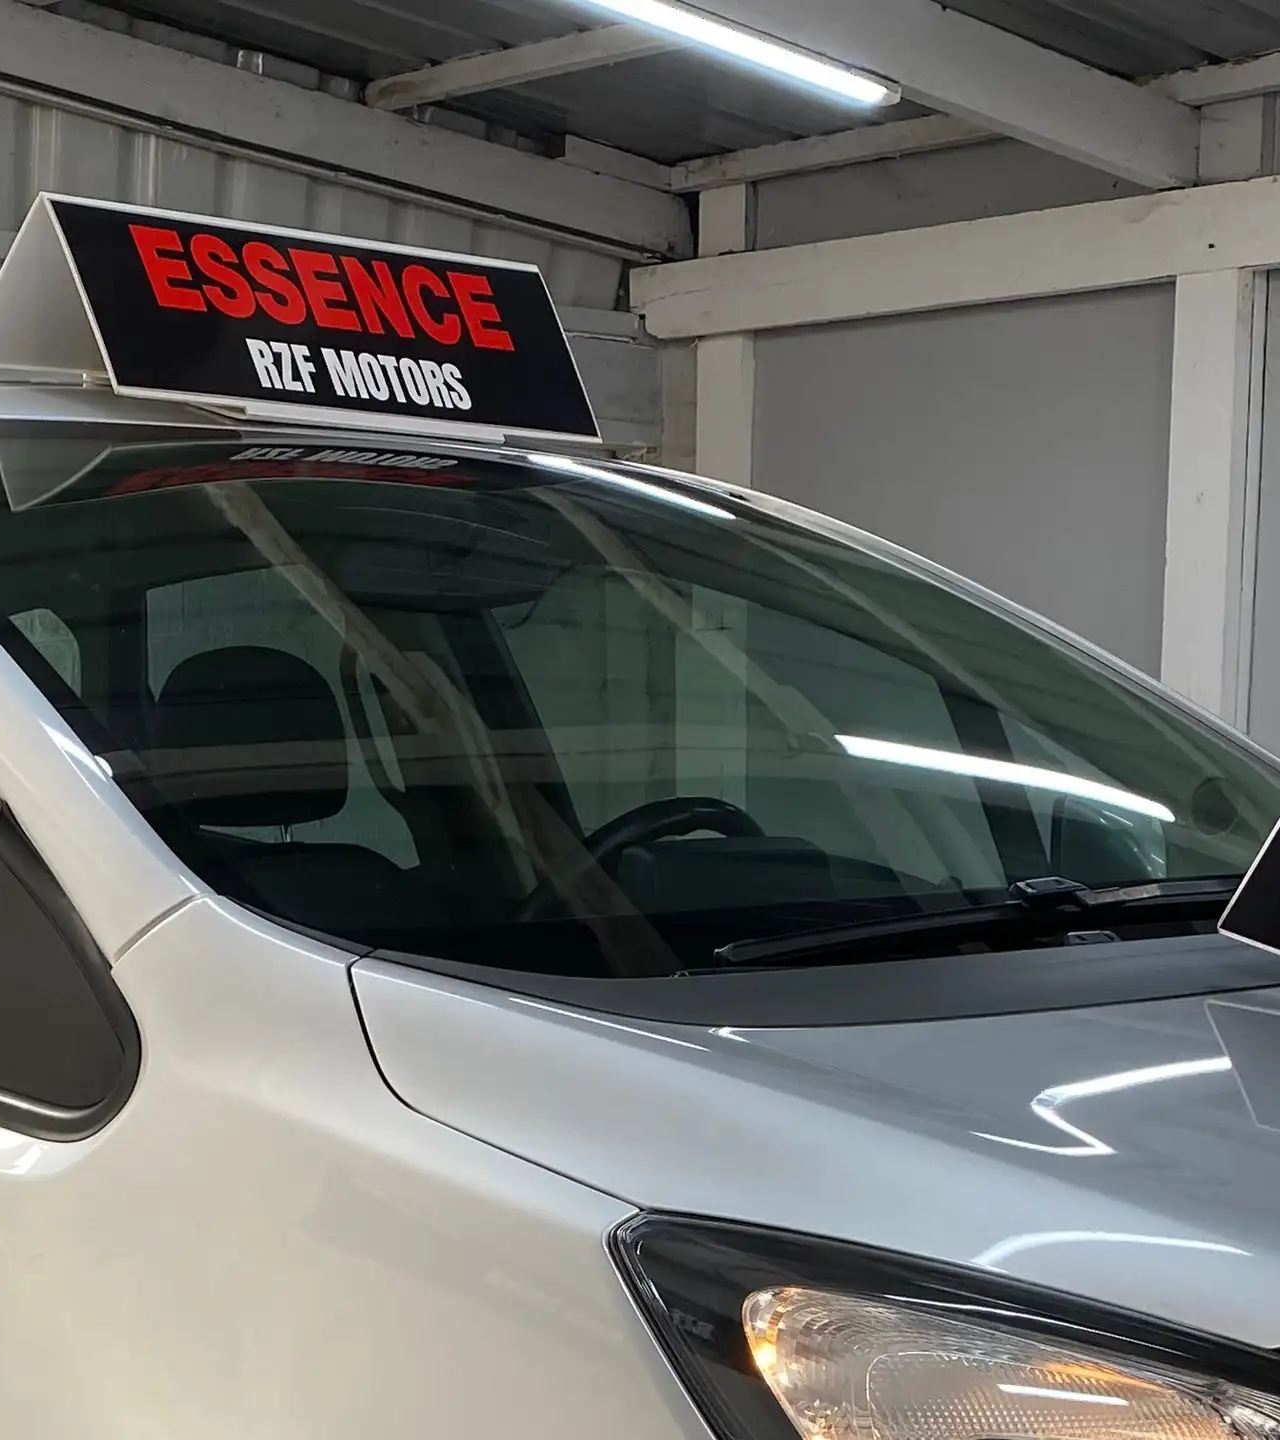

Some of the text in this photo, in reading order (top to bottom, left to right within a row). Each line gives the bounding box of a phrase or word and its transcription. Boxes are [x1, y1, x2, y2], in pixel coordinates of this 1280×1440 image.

[128, 224, 514, 352] ESSENCE
[246, 338, 472, 410] RZF MOTORS
